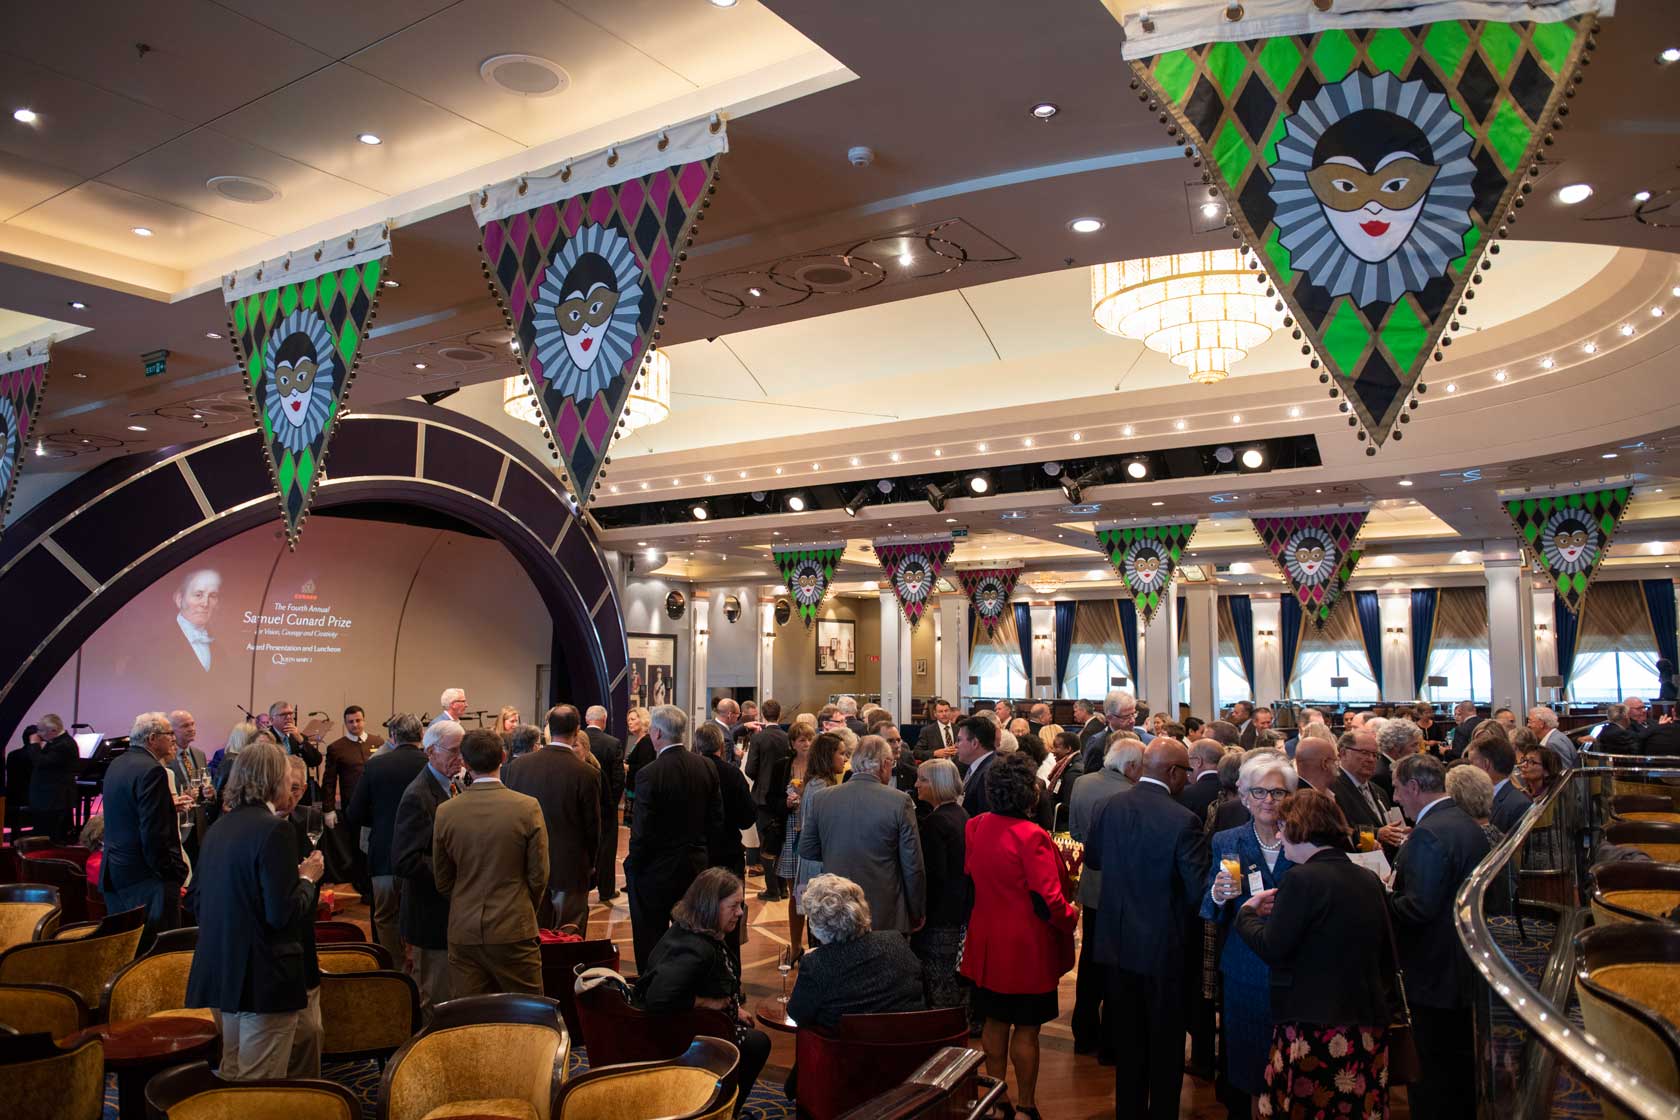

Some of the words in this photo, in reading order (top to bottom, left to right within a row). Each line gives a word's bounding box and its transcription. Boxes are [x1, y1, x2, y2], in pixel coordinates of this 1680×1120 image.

[275, 602, 286, 610] The
[288, 603, 308, 612] Fourth
[309, 604, 331, 612] Annual
[286, 614, 326, 626] Cunard
[328, 616, 352, 628] Prize
[266, 643, 301, 652] Presentation
